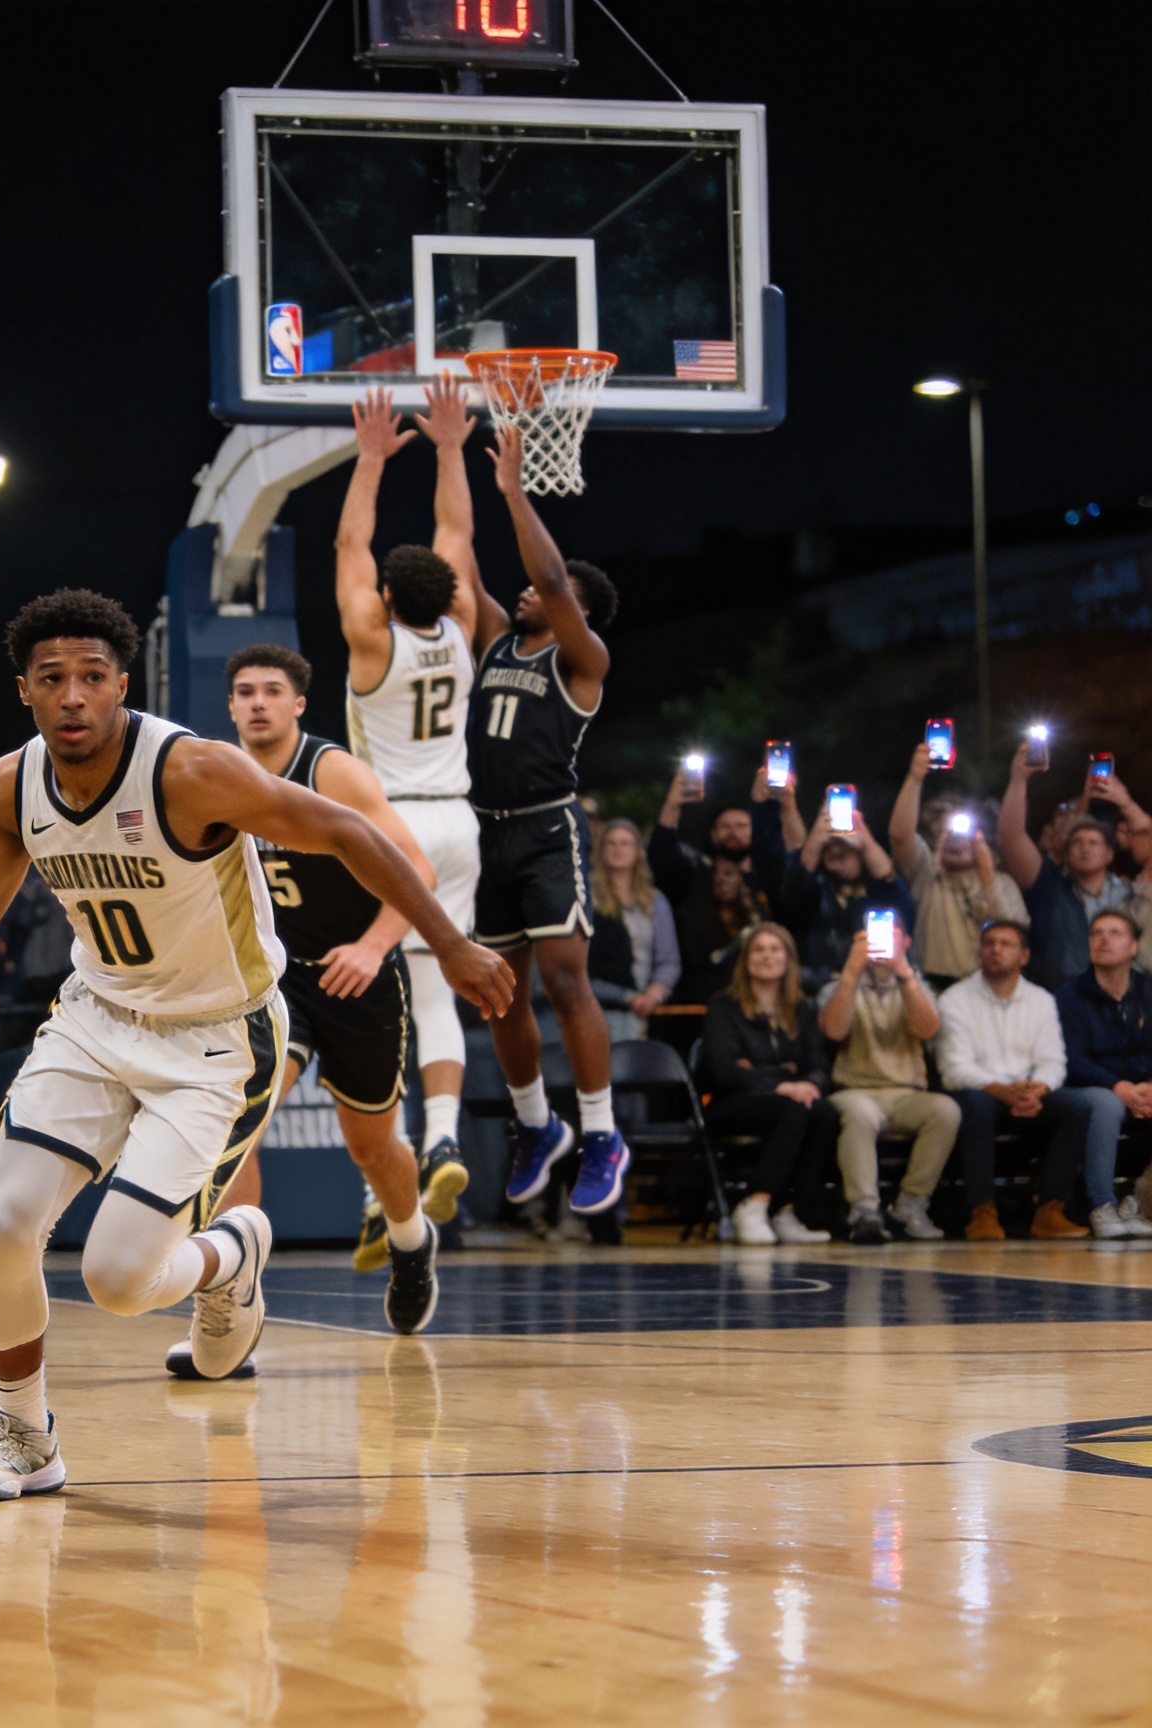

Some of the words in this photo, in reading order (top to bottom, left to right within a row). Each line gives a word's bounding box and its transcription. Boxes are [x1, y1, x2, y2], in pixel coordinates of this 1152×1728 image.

[456, 0, 528, 37] 10
[411, 676, 455, 740] 12
[487, 694, 518, 740] 11
[76, 899, 155, 966] 10
